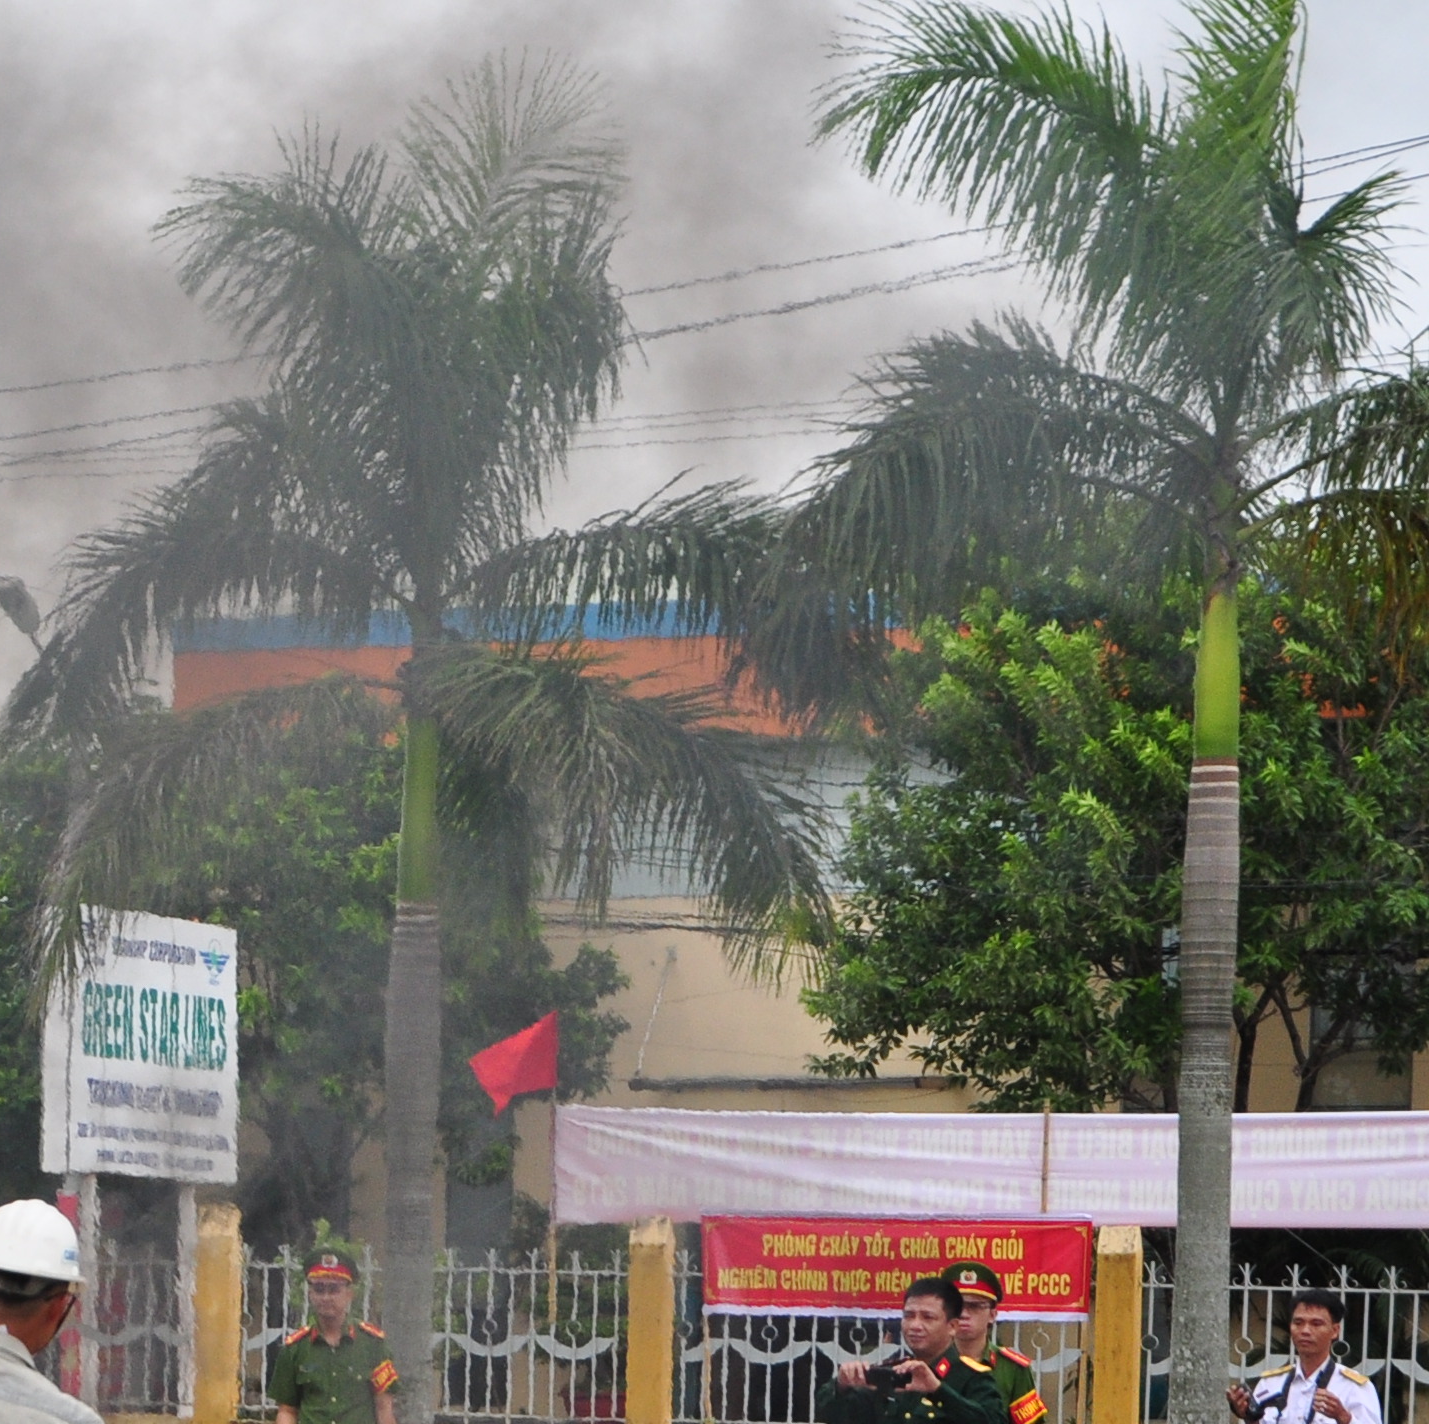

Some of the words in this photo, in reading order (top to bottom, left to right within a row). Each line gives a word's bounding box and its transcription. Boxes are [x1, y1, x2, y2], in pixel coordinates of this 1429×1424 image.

[82, 979, 134, 1060] GREEN
[139, 987, 180, 1069] STAR
[183, 993, 227, 1071] LINES
[762, 1229, 817, 1257] PHÒNG
[819, 1230, 860, 1258] CHÁY
[863, 1230, 896, 1261] TỐT,
[899, 1231, 941, 1260] CHỮA
[945, 1233, 988, 1260] CHÁY
[991, 1229, 1025, 1261] GIỎI
[717, 1264, 778, 1289] NGHIÊM
[831, 1268, 872, 1297] THỰC
[874, 1267, 912, 1297] HIỆN
[1004, 1266, 1026, 1296] VỀ
[1026, 1273, 1072, 1297] PCCC
